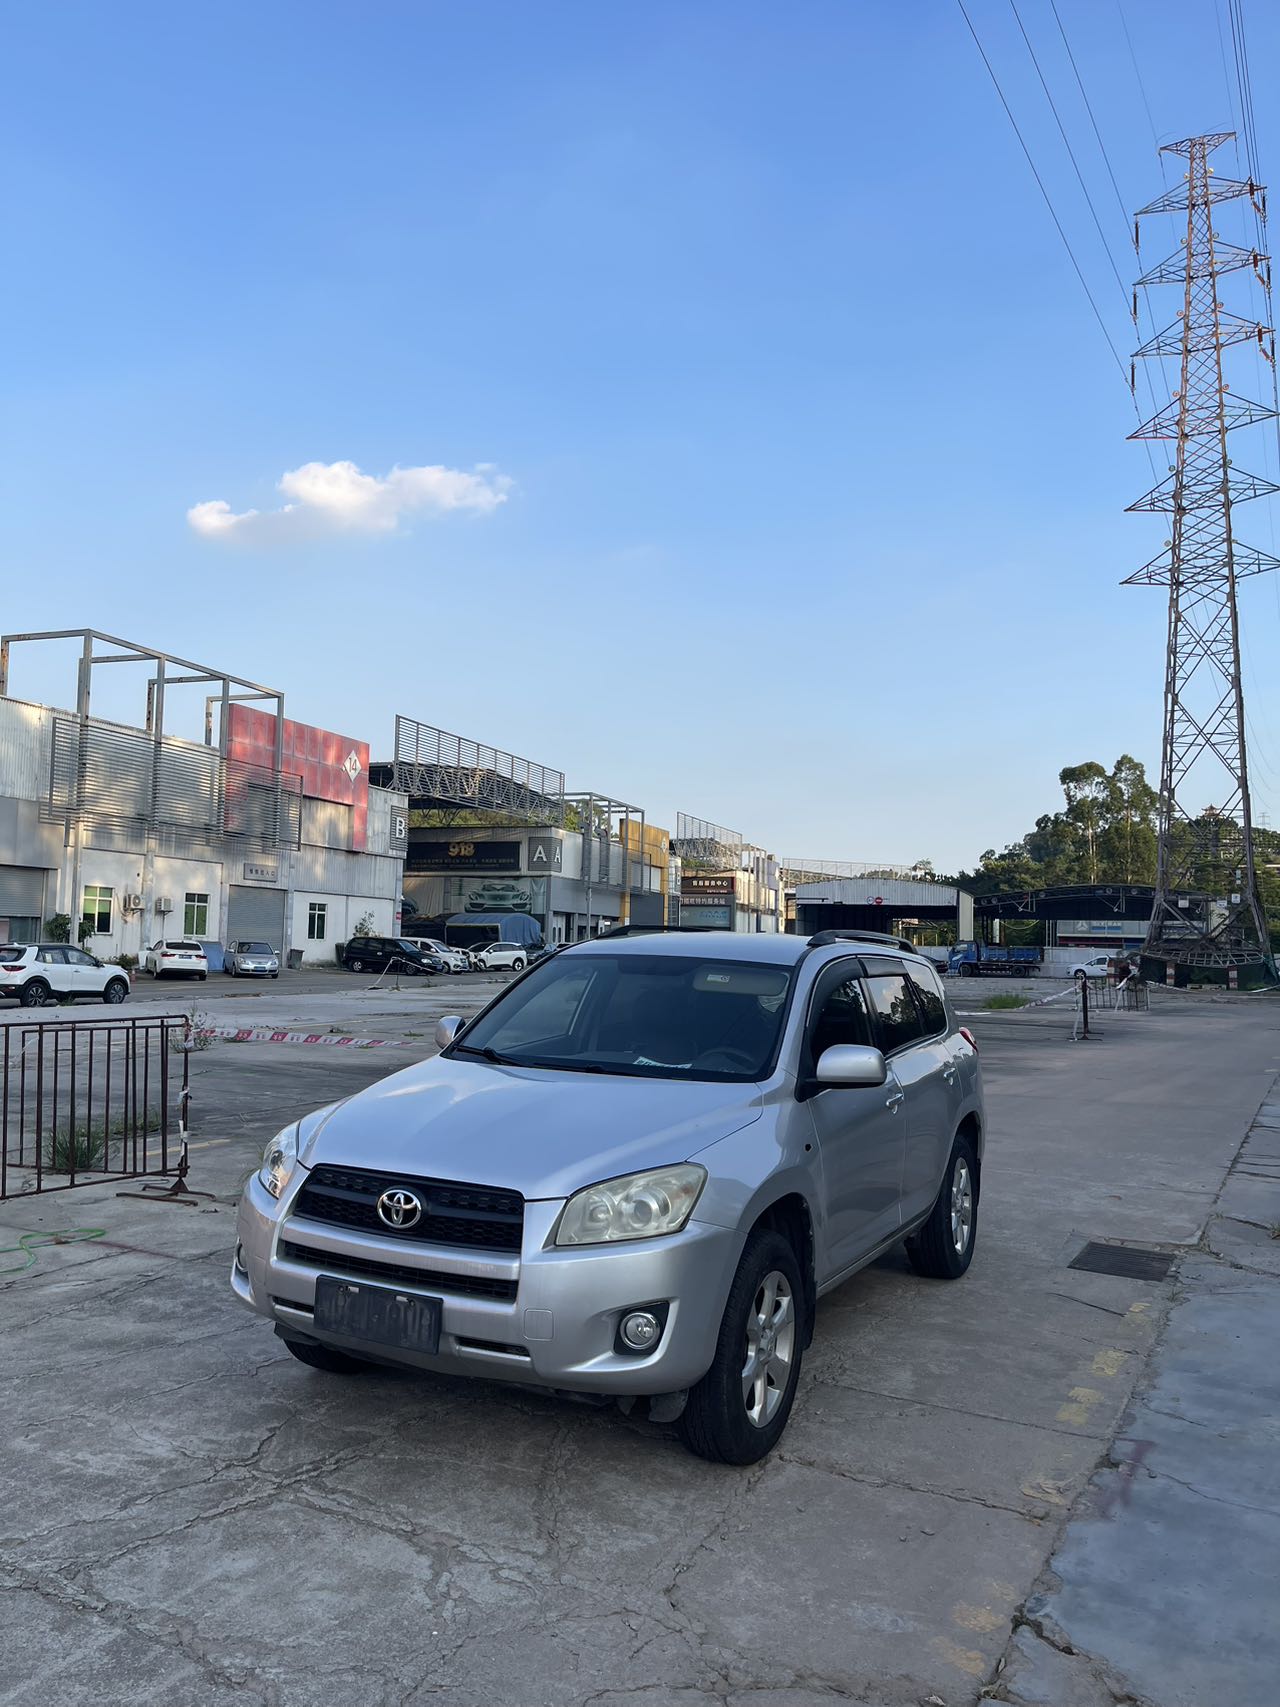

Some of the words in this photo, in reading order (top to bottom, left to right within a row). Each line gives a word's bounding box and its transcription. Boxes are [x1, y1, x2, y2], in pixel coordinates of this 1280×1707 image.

[348, 757, 357, 773] 14
[395, 816, 405, 838] B
[448, 842, 475, 857] 918
[533, 845, 548, 862] A
[554, 846, 561, 863] A
